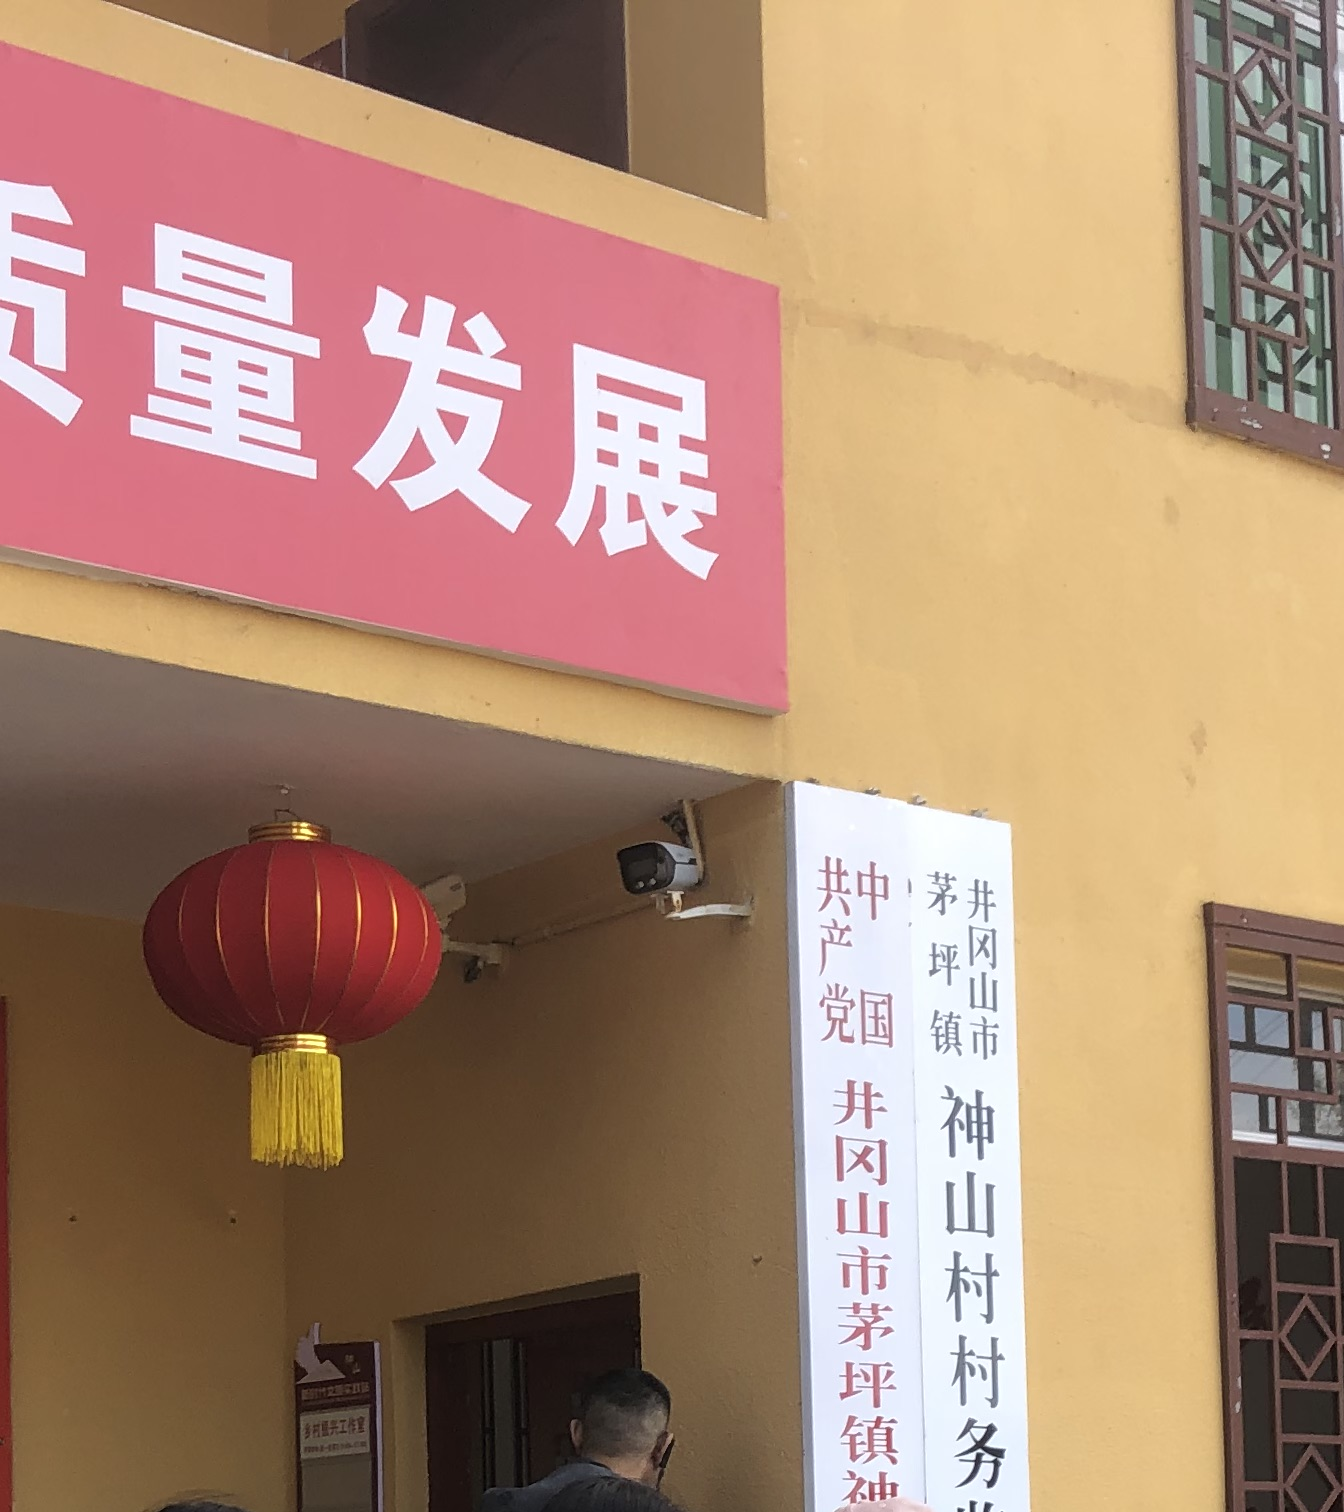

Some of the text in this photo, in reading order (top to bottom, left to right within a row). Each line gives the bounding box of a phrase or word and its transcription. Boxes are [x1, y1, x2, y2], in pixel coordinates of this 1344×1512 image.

[927, 870, 964, 1057] 茅坪镇
[966, 878, 999, 1061] 井冈山市
